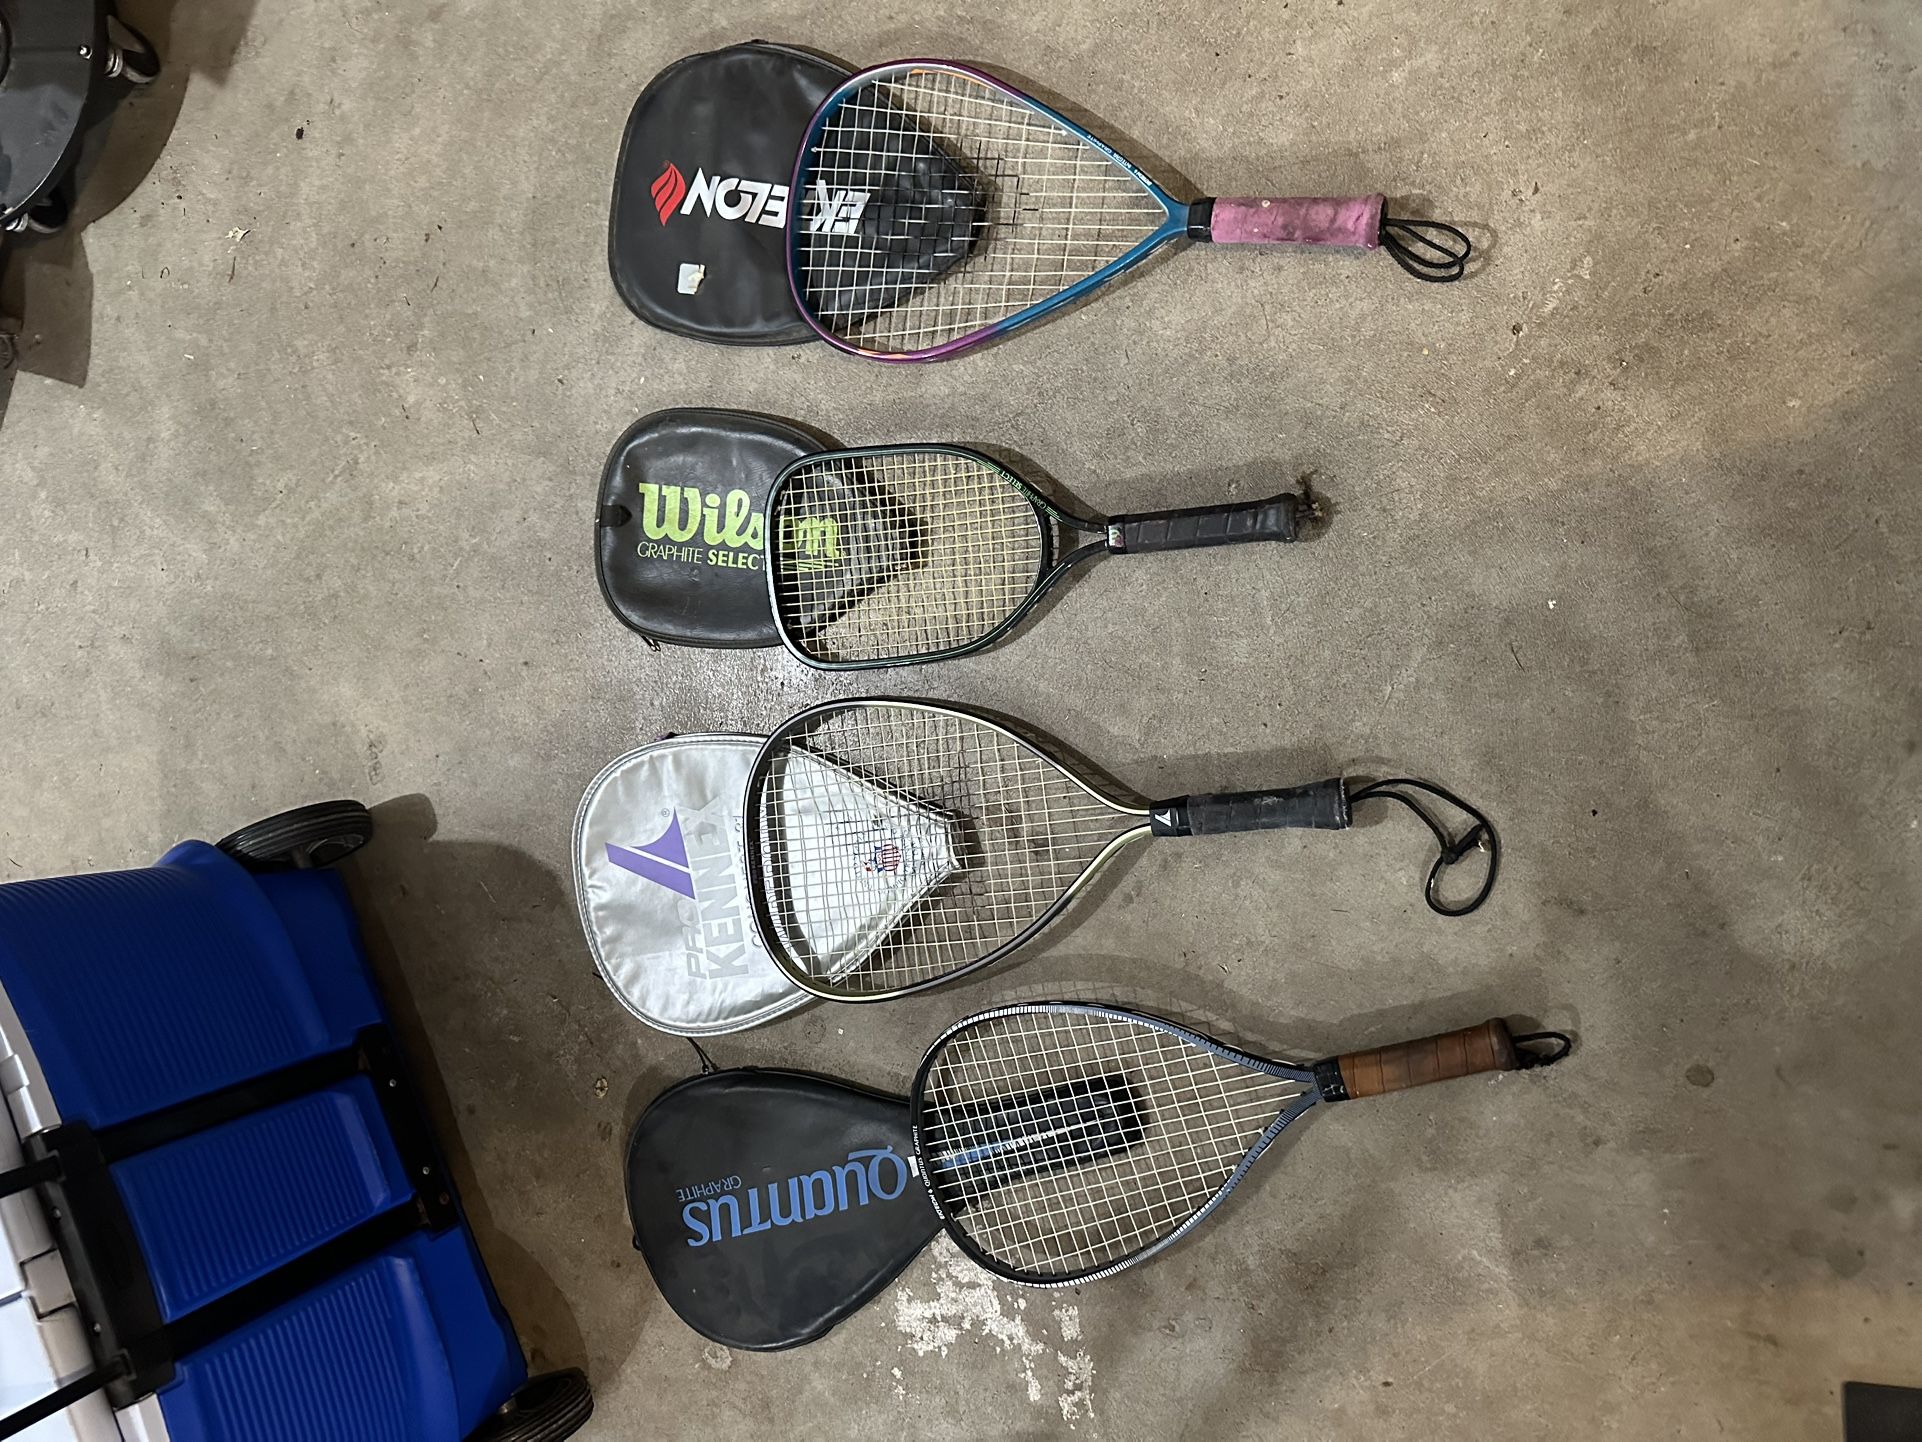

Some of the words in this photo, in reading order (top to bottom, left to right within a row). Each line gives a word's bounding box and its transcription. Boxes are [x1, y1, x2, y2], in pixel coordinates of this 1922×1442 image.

[1000, 470, 1023, 490] SELECT
[637, 541, 703, 565] GRAPHITE
[676, 796, 750, 980] KENNEX
[675, 895, 708, 980] PRO
[676, 1175, 742, 1202] GRAPHITE
